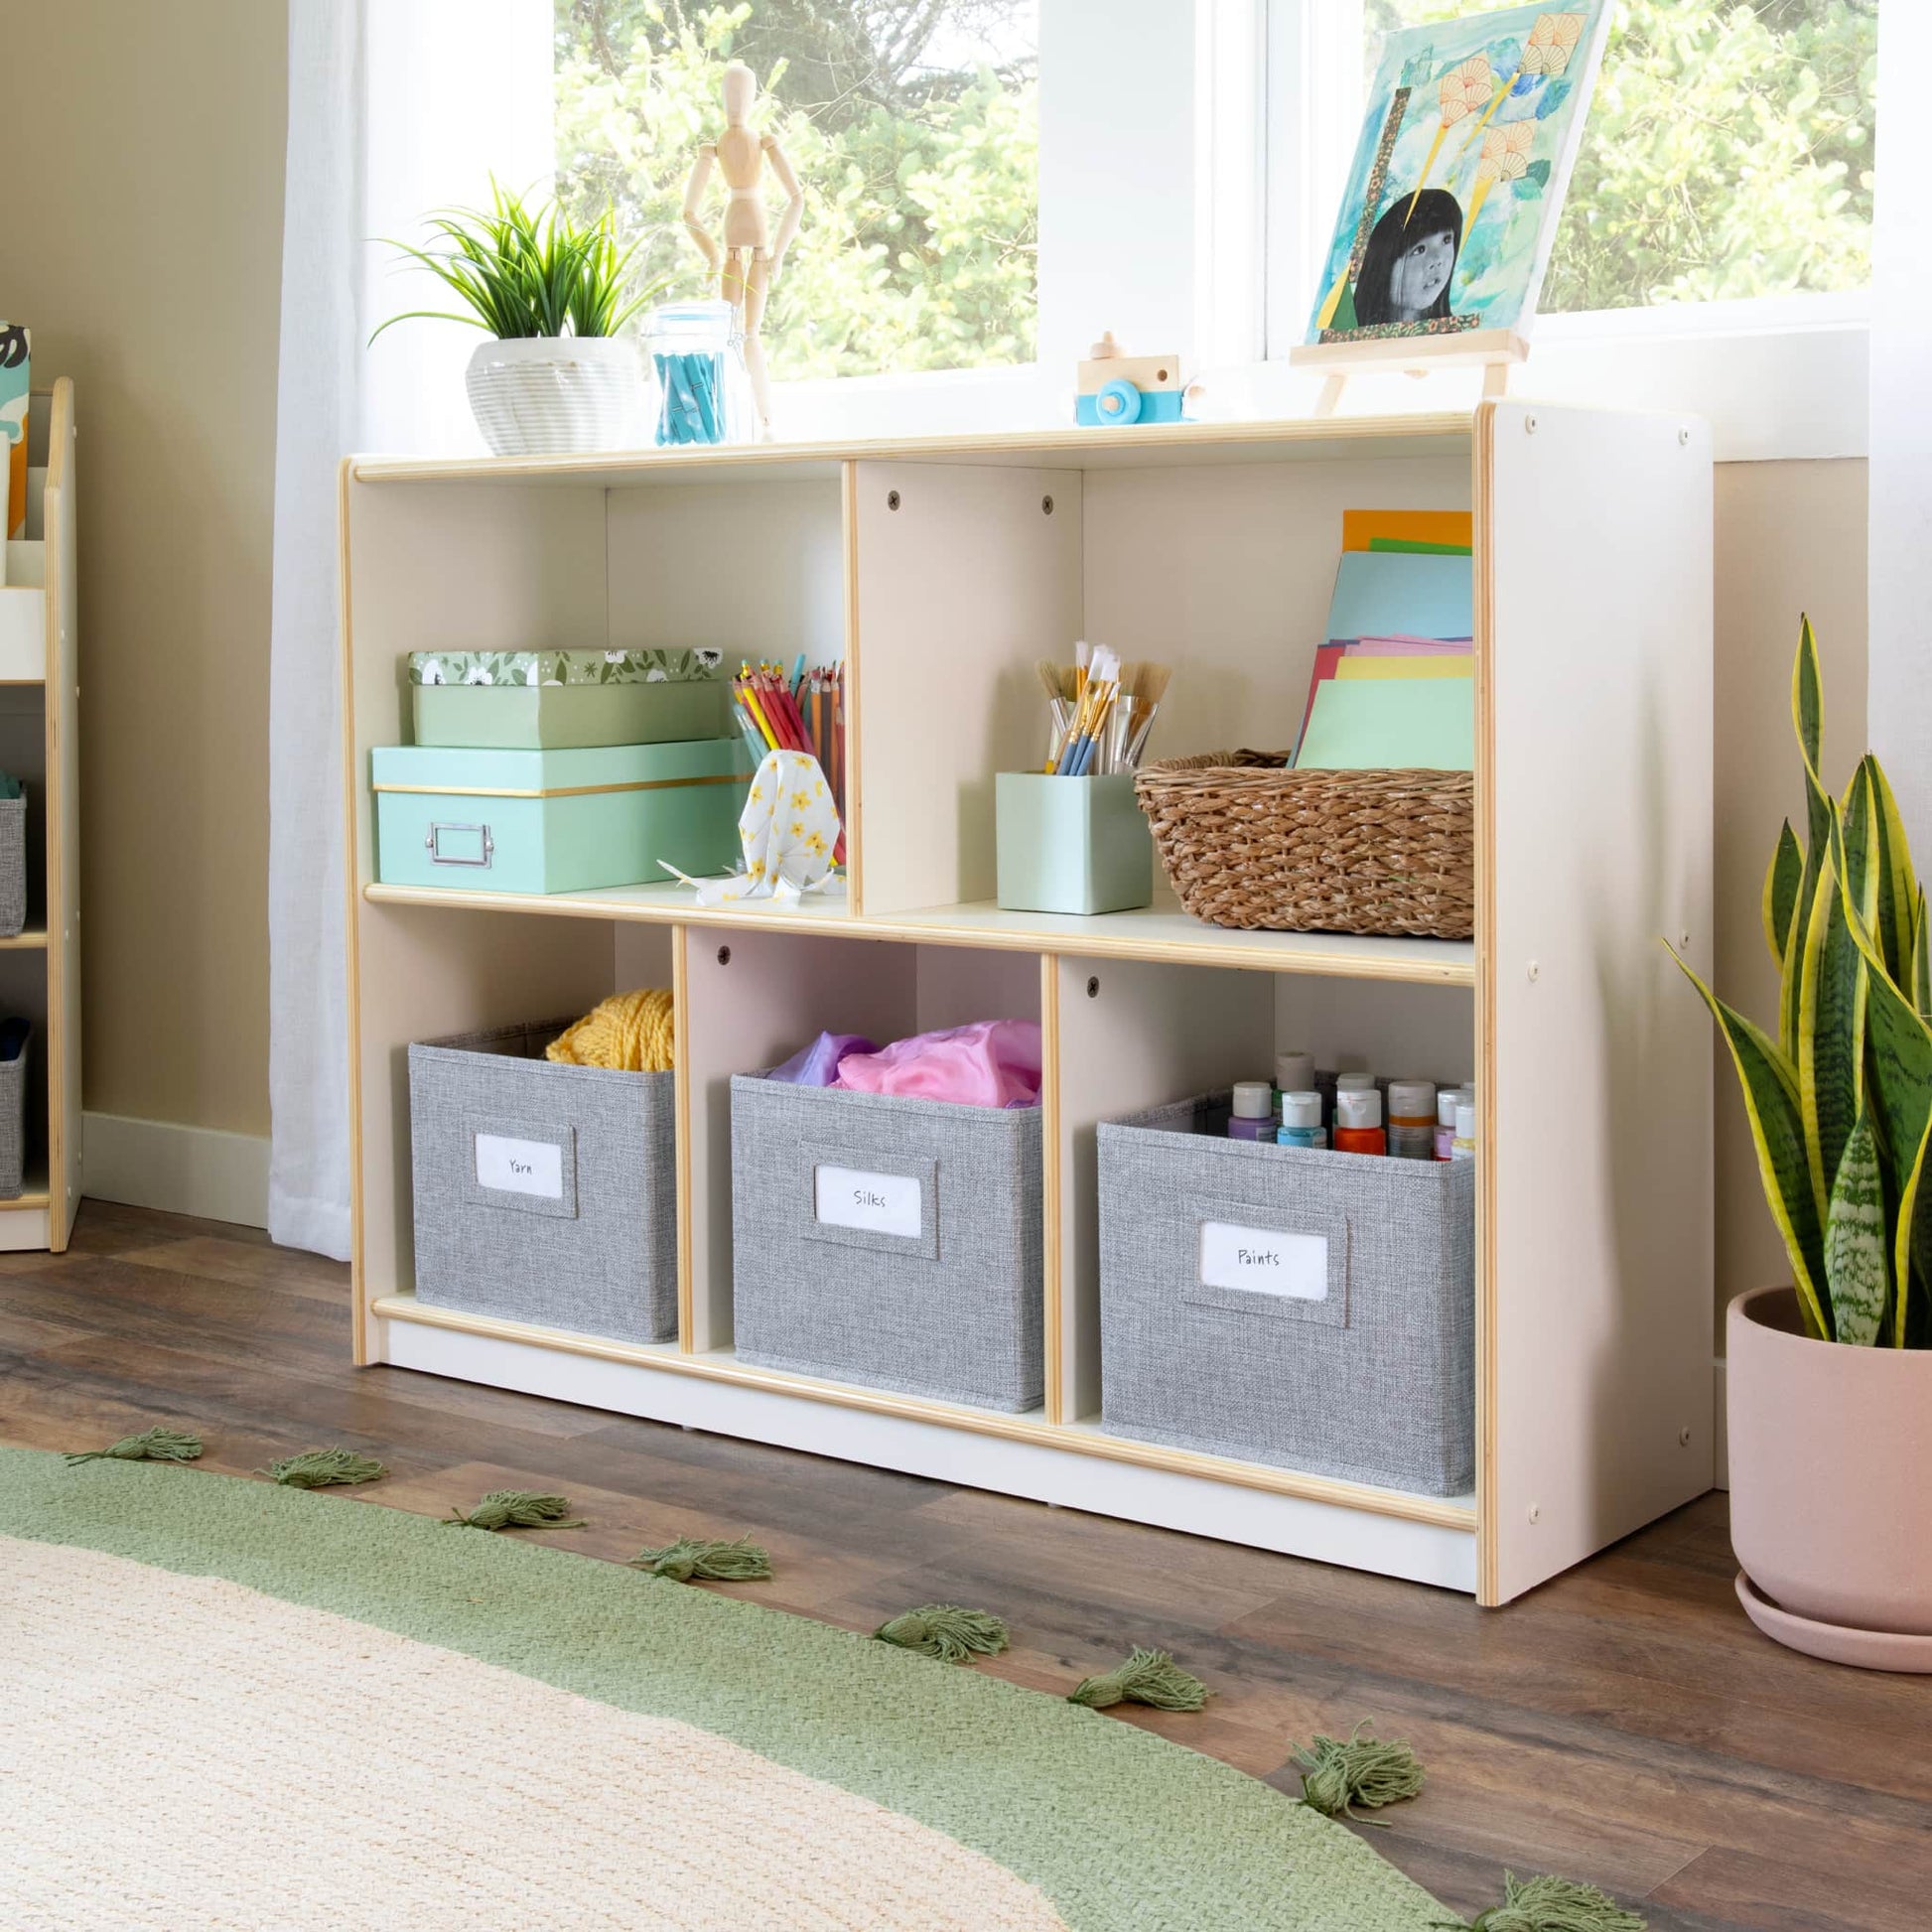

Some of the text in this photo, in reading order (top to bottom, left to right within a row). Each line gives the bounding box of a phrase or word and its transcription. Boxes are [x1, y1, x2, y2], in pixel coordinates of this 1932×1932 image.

[509, 1159, 532, 1174] Yarn
[854, 1190, 886, 1207] Silks
[1238, 1249, 1280, 1266] Paints
